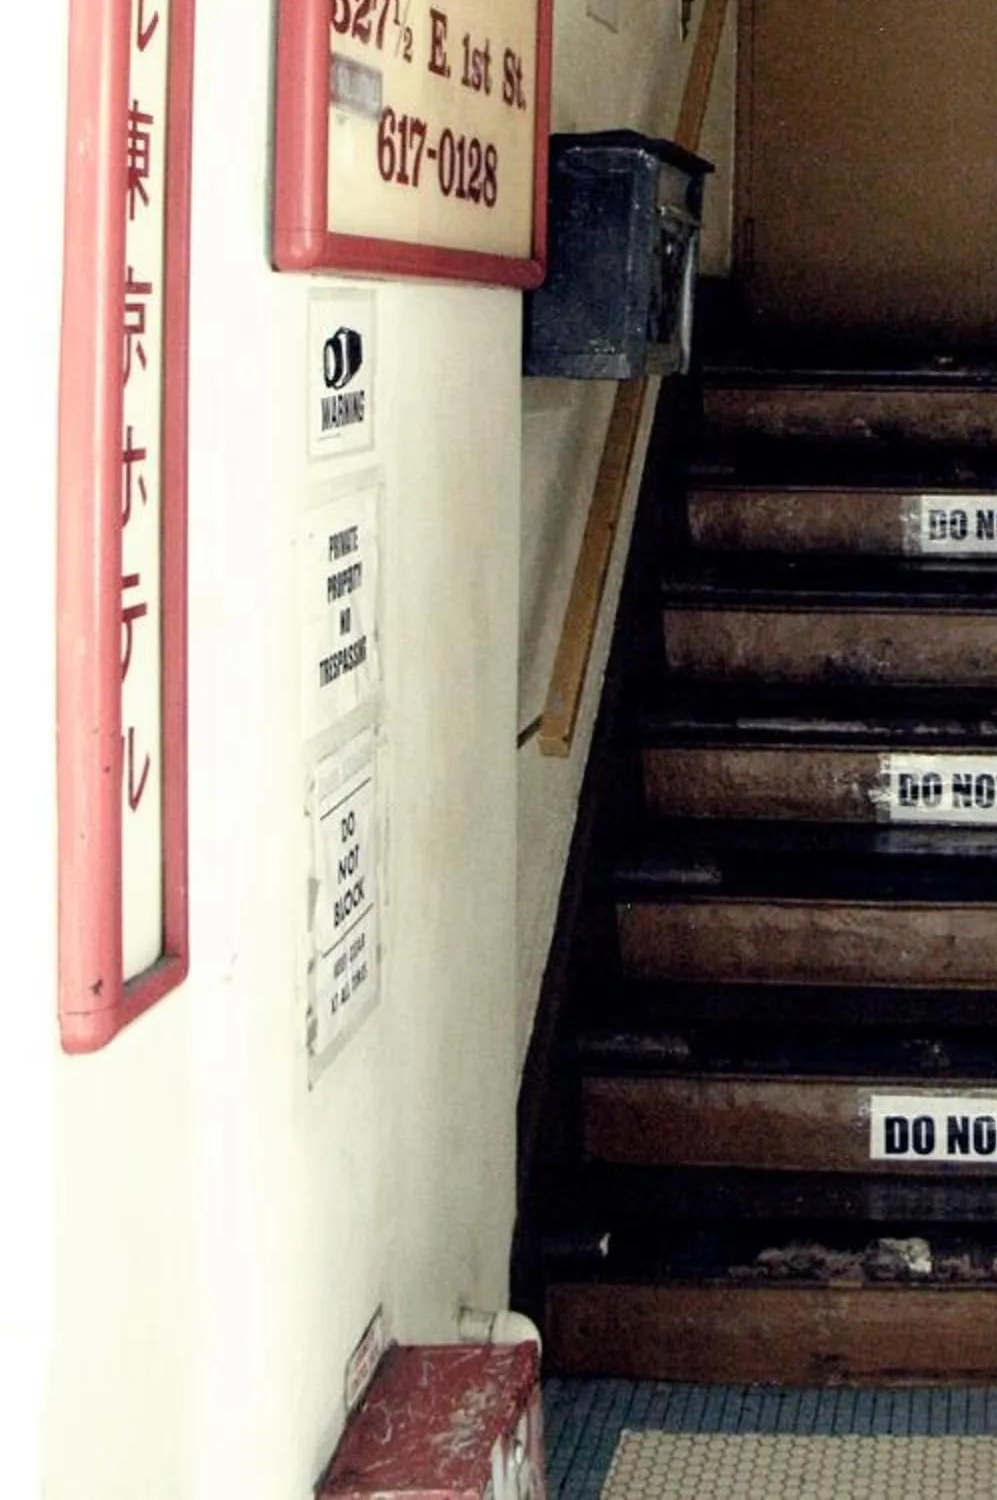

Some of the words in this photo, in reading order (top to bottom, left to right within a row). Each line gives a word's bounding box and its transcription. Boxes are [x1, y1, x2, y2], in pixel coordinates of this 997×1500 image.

[461, 33, 493, 97] 1st
[502, 47, 527, 112] St.
[377, 105, 499, 210] 617-0128
[320, 390, 365, 432] WARNING
[328, 524, 359, 562] PRIVATE
[928, 509, 968, 541] DO
[327, 562, 362, 604] PROPERTY
[339, 607, 351, 637] NO
[319, 636, 367, 688] TRESPASSING
[898, 772, 943, 808] DO
[341, 810, 355, 843] DO
[338, 843, 360, 885] NOT
[333, 875, 365, 928] BLOCK
[884, 1115, 935, 1155] DO
